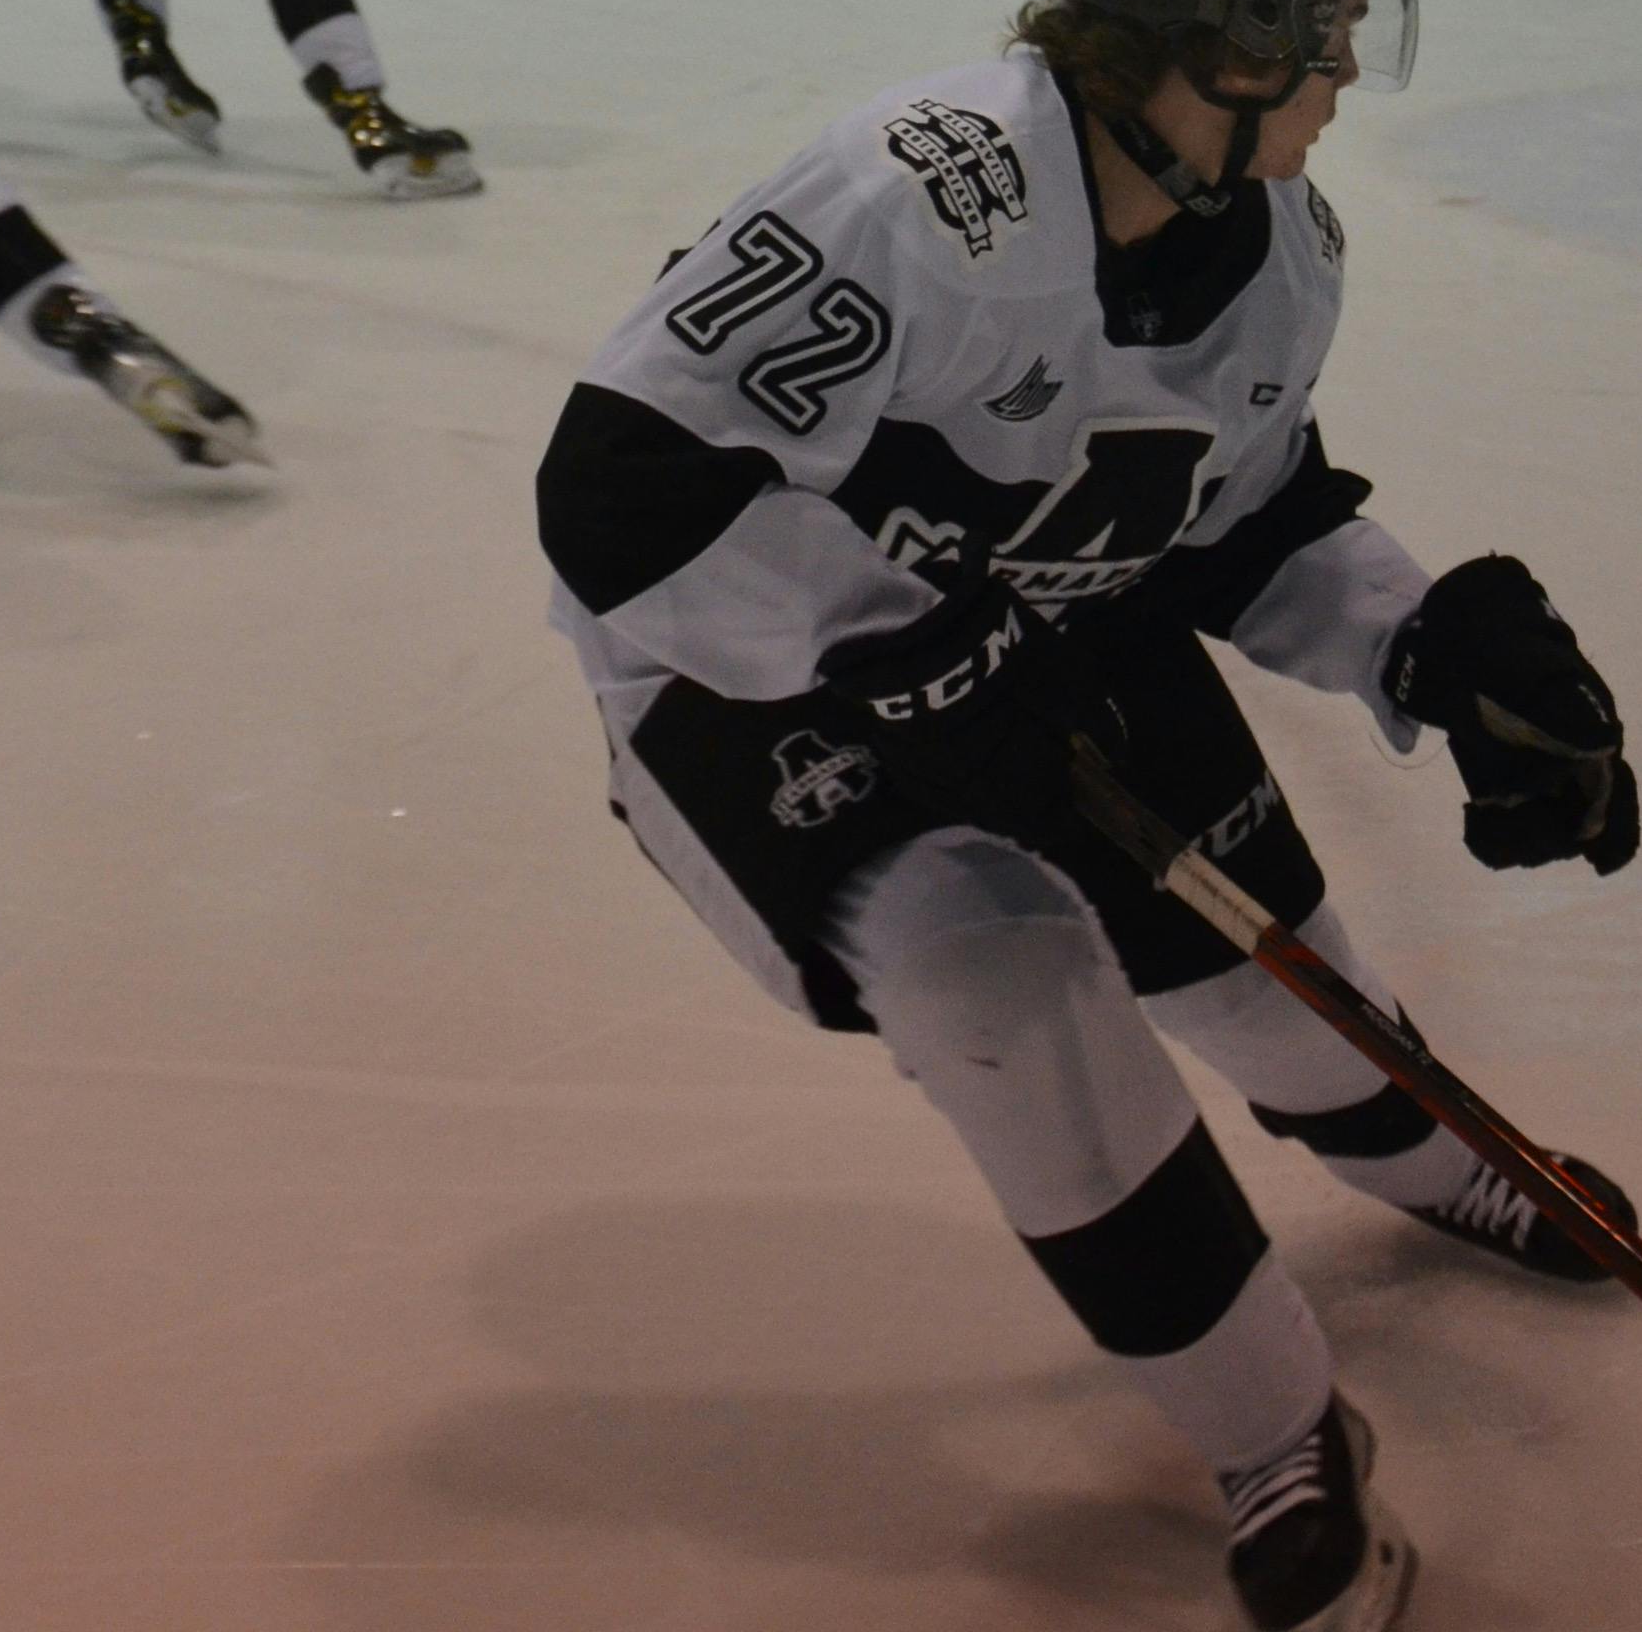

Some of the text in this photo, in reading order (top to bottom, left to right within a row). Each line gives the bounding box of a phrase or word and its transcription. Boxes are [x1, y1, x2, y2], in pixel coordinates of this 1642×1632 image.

[900, 126, 980, 225] BOISBRIAND
[942, 112, 1017, 202] BLAINVILLE
[666, 210, 892, 436] 72
[1250, 383, 1284, 405] C
[867, 604, 1025, 721] CCM
